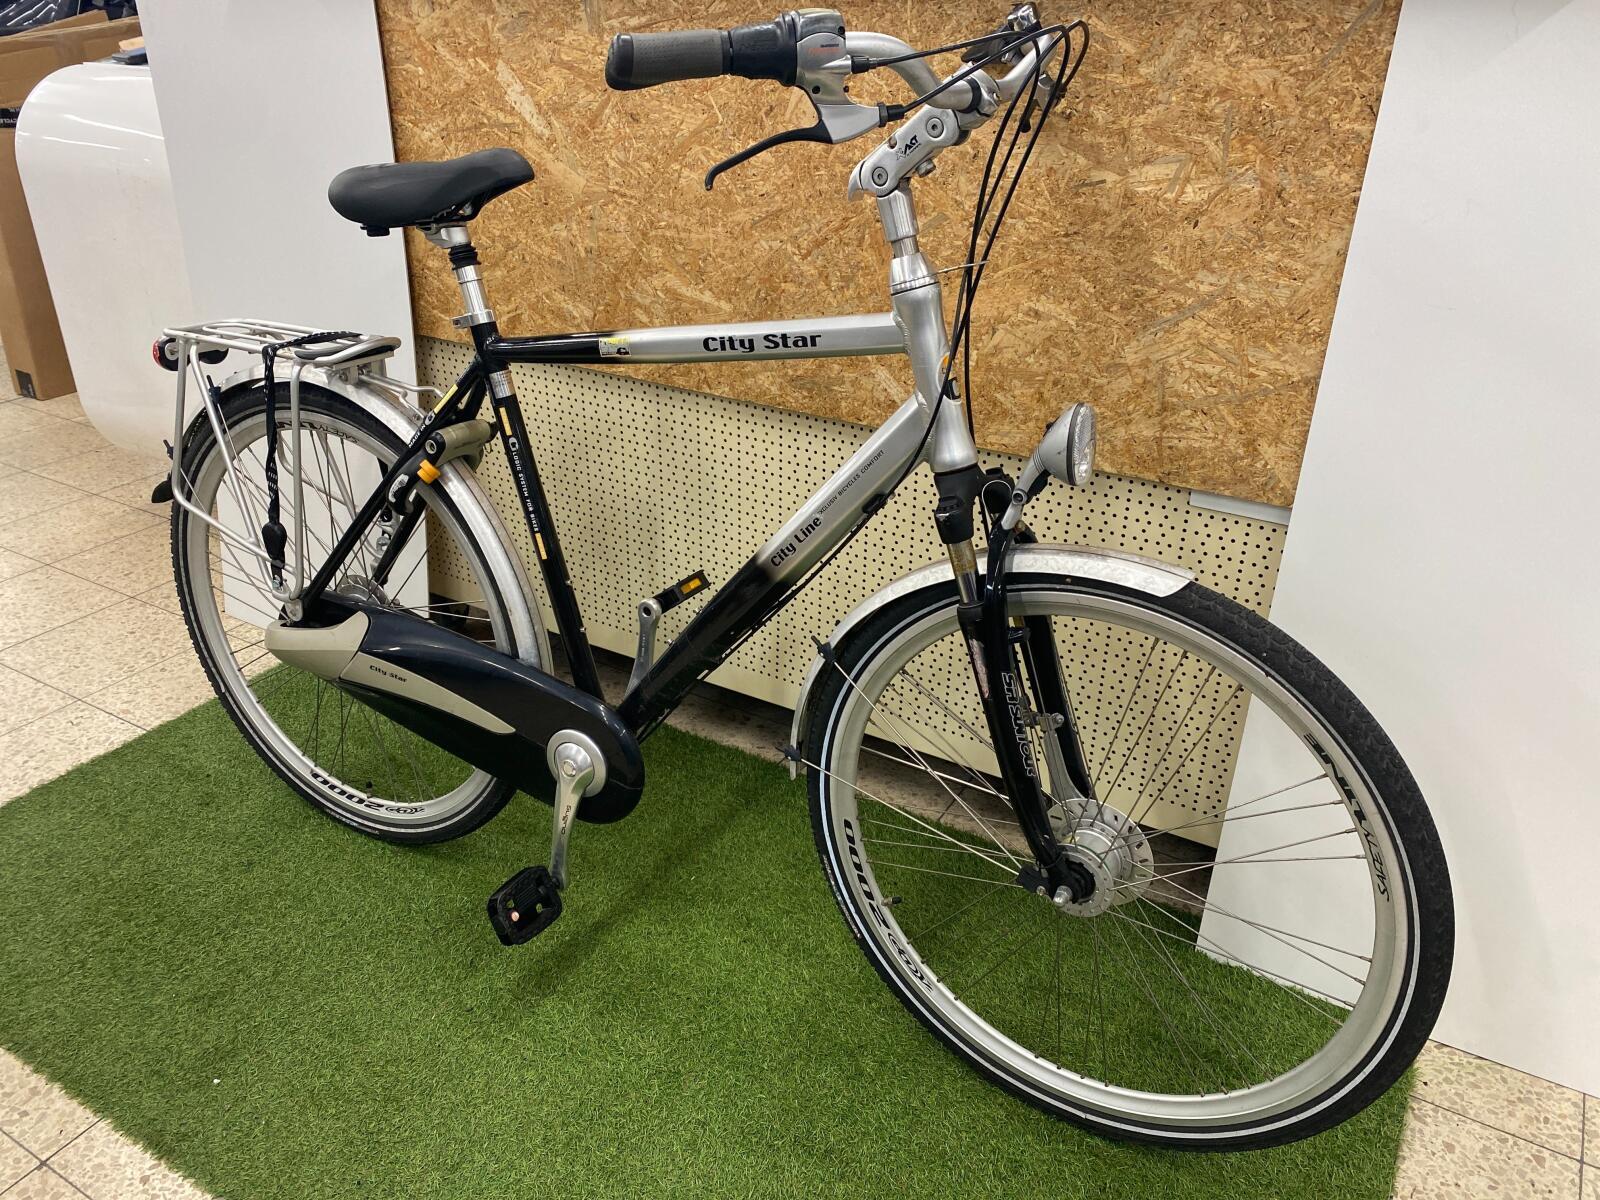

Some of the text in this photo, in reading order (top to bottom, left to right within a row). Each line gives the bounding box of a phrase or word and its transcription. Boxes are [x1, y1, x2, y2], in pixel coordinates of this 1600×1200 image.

[702, 333, 822, 353] City Star
[518, 473, 529, 498] SYSTEM
[770, 541, 796, 568] City
[794, 516, 823, 544] Line
[837, 473, 861, 497] BICYCLES
[860, 449, 885, 474] COMFORT
[369, 664, 408, 683] City Star
[311, 772, 385, 814] 2000
[843, 818, 891, 931] 2000
[1359, 824, 1390, 902] SAFETY
